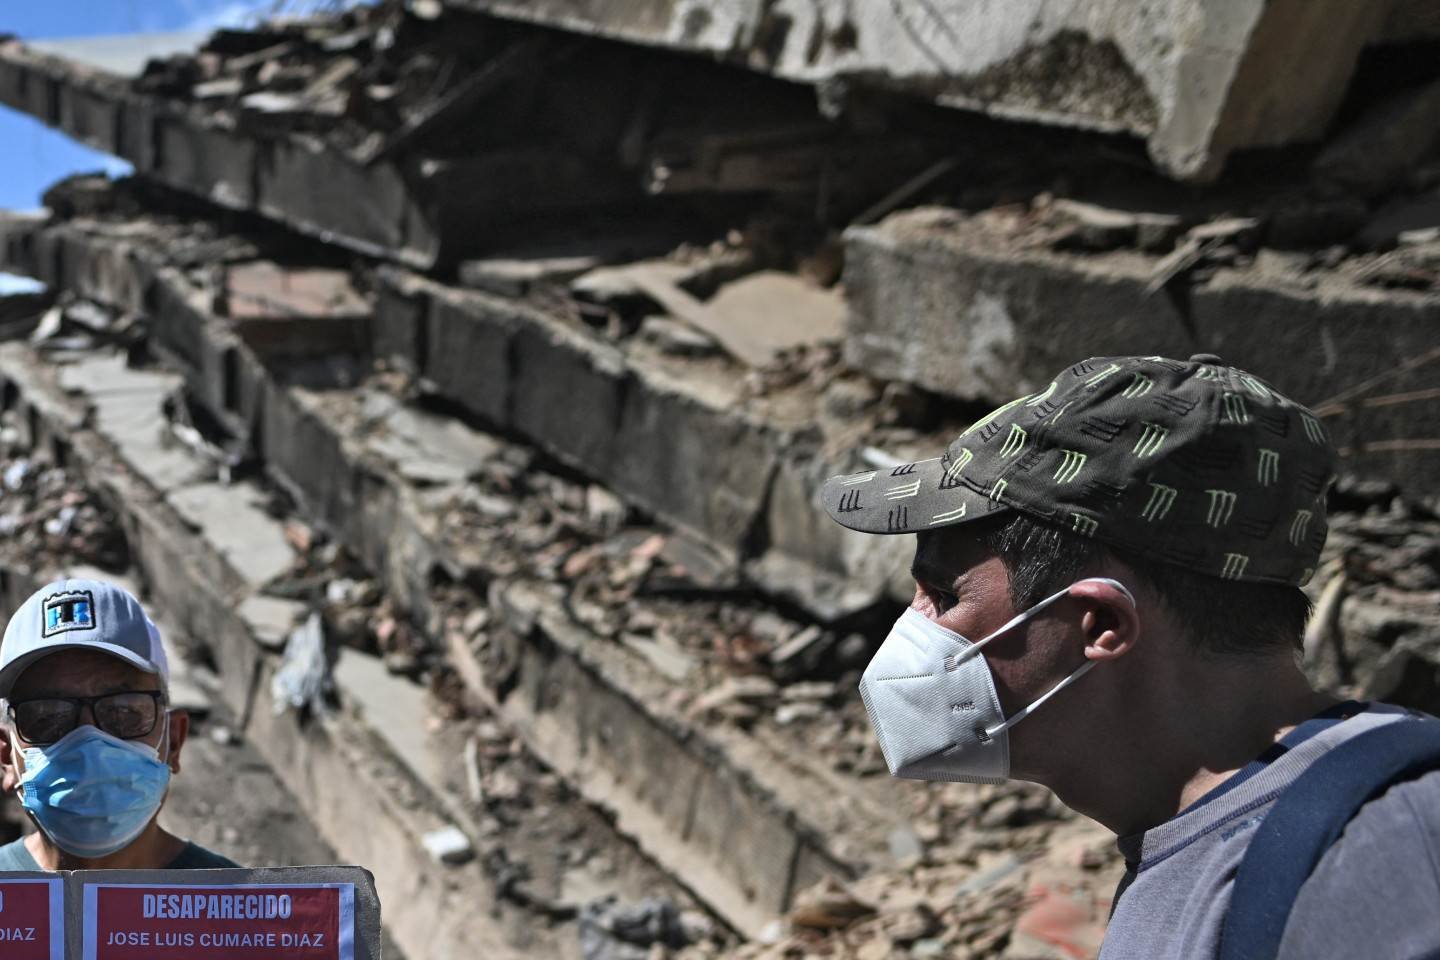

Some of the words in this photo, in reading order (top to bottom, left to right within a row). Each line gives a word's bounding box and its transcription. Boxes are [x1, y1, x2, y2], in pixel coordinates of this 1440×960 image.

[143, 894, 292, 919] DESAPARECIDO
[107, 932, 150, 946] JOSE
[155, 933, 195, 946] LUIS
[199, 933, 276, 947] CUMARE
[281, 933, 324, 948] DIAZ
